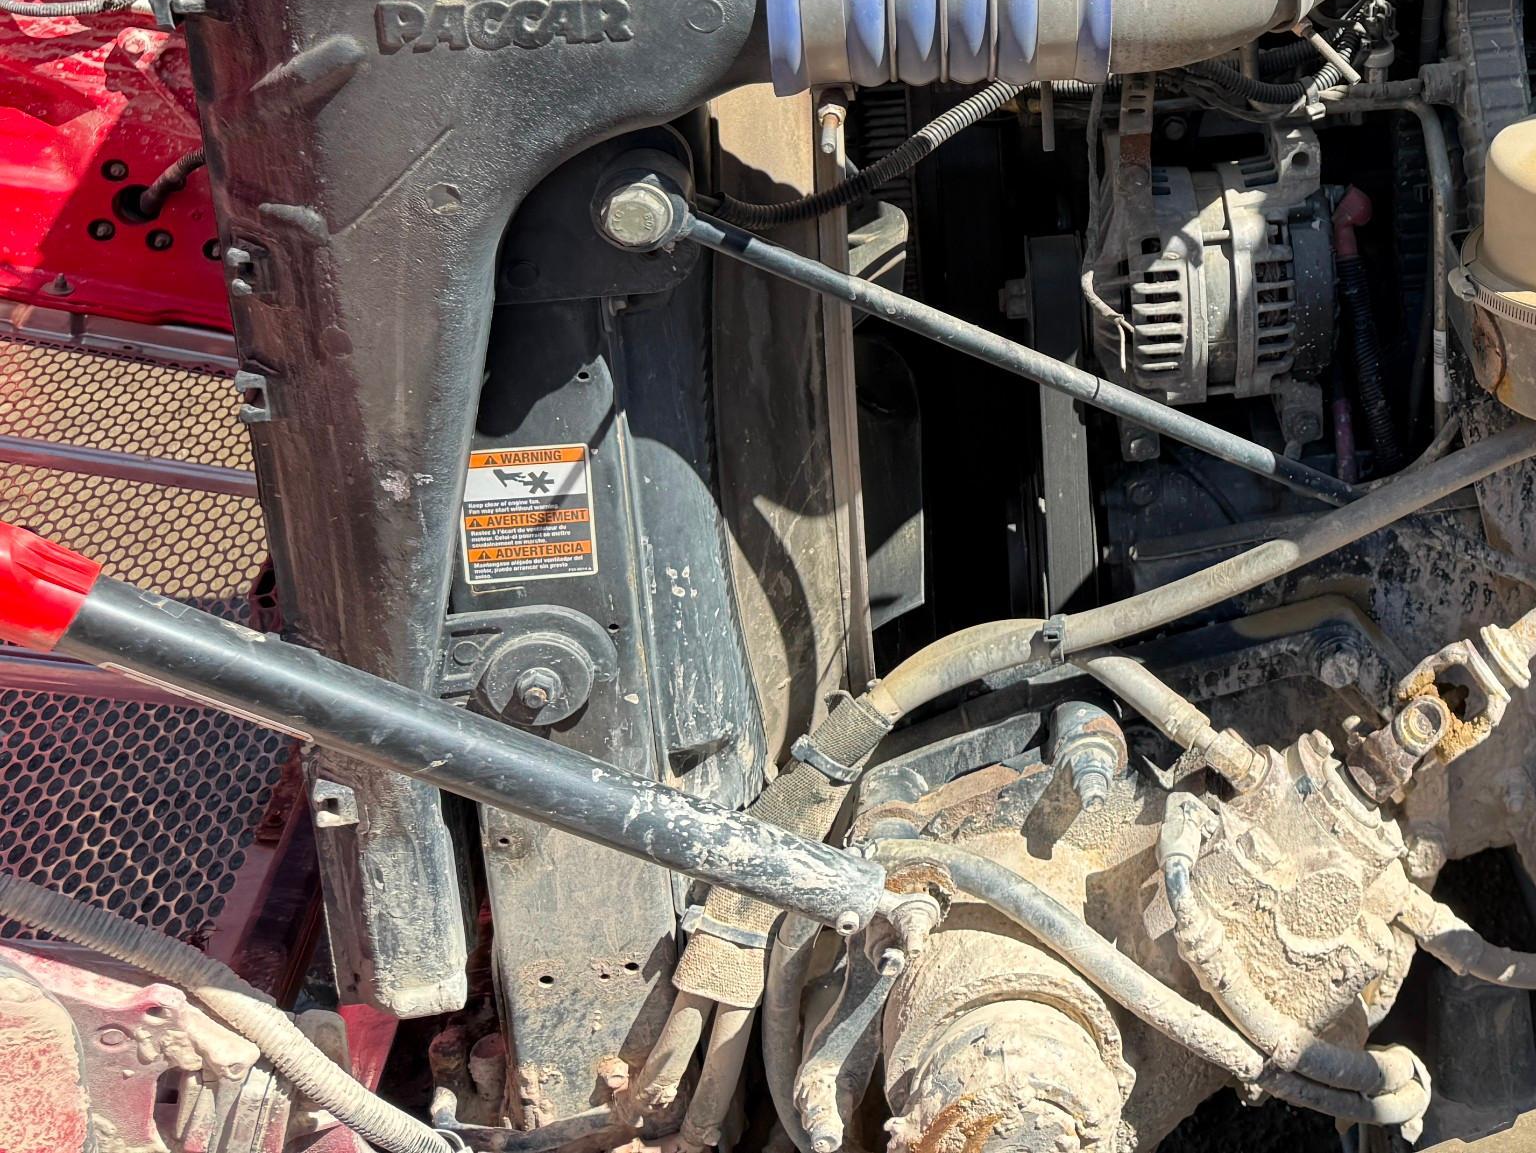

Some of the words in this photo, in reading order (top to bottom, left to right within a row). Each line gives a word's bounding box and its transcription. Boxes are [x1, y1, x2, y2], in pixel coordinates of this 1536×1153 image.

[500, 450, 562, 464] WARNING
[486, 509, 586, 527] AVERTISSEMENT
[495, 542, 584, 559] ADVERTENCIA
